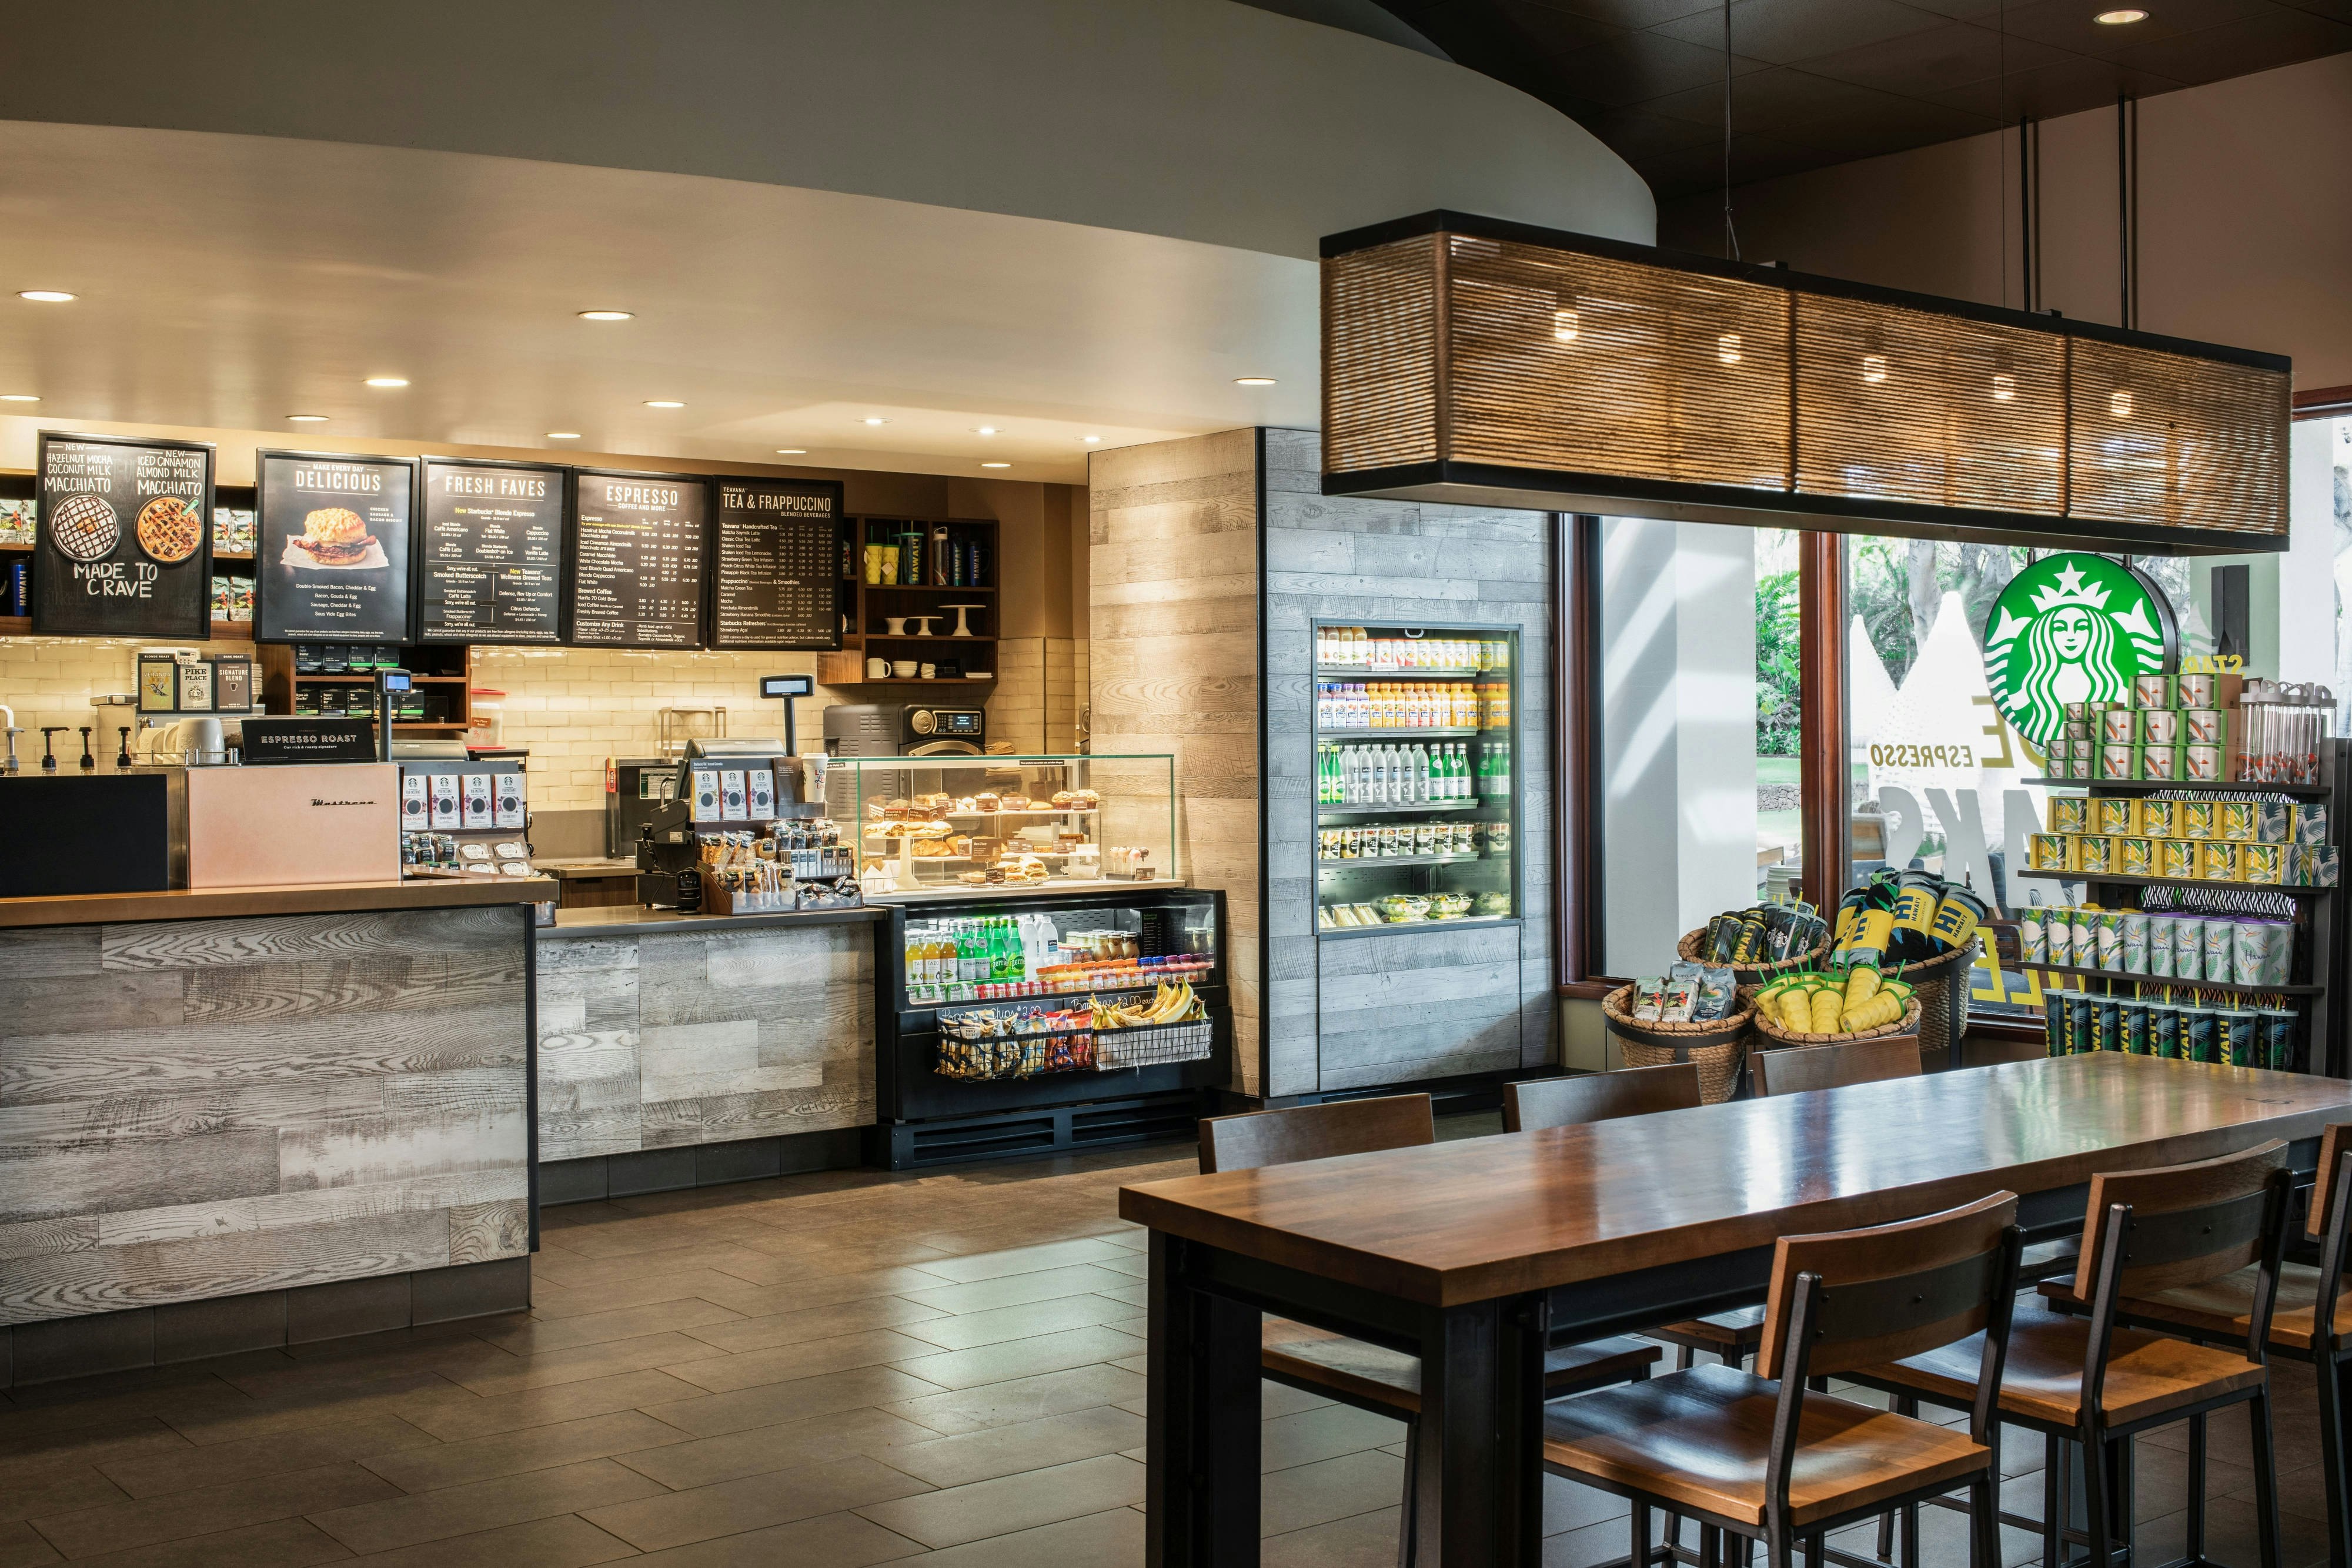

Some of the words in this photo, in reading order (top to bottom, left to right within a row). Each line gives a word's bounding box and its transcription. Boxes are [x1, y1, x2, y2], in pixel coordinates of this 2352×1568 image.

[47, 453, 85, 464] HAZELNUT
[87, 455, 112, 464] MOCHA
[138, 456, 155, 465] ICED
[158, 457, 201, 468] CINNAMON
[48, 464, 85, 474] COCONUT
[88, 465, 111, 476] MILK
[136, 467, 169, 477] ALMOND
[174, 469, 198, 477] MILK
[45, 477, 111, 493] MACCHIATO
[138, 480, 202, 495] MACCHIATO
[296, 471, 380, 490] DELICIOUS
[724, 494, 743, 508] TEA
[747, 494, 755, 509] &
[760, 495, 831, 511] FRAPPUCCINO
[74, 563, 125, 579] MADE
[135, 563, 158, 581] TO
[88, 580, 152, 597] CRAVE
[261, 735, 318, 744] ESPRESSO
[322, 734, 356, 743] ROAST
[1911, 897, 1921, 921] HAWAI'I
[1933, 906, 1962, 934] HI
[1953, 915, 1967, 938] HAWAI'I
